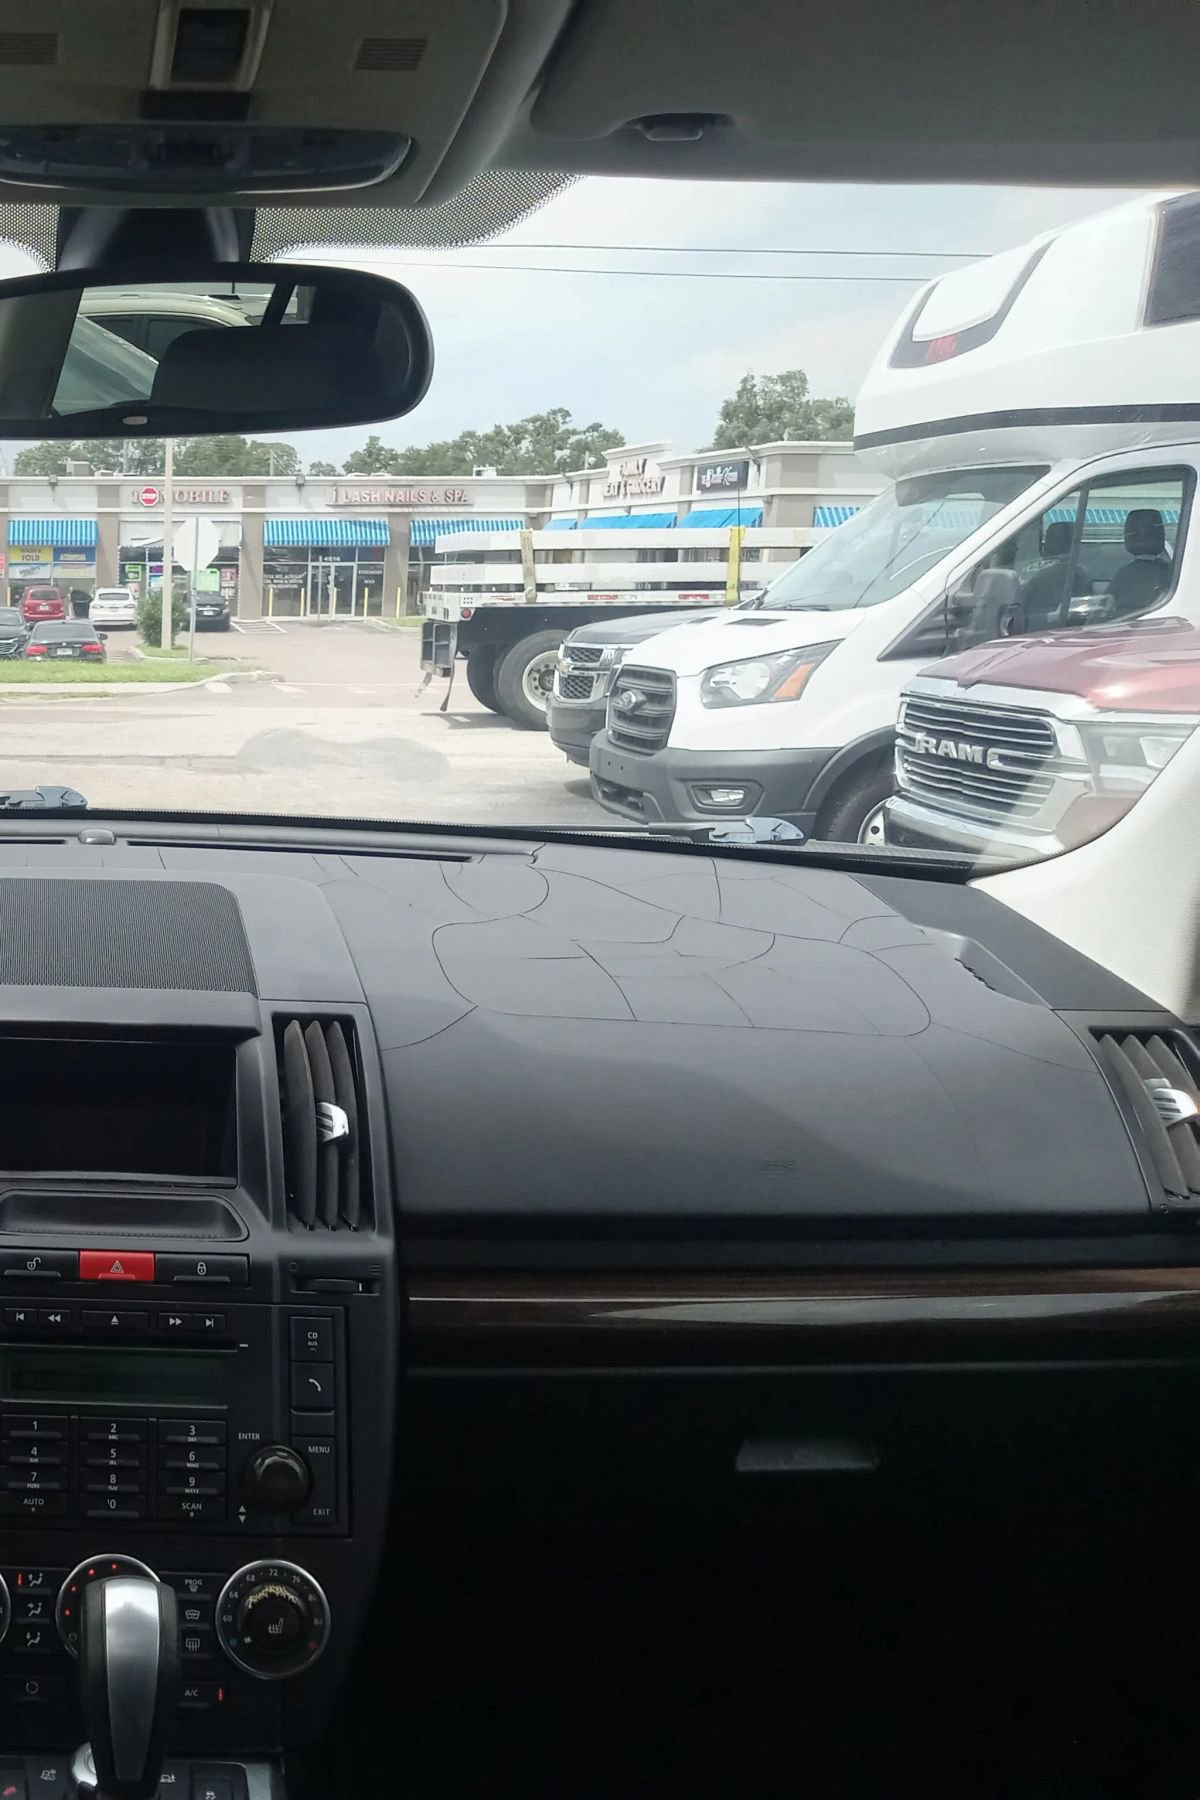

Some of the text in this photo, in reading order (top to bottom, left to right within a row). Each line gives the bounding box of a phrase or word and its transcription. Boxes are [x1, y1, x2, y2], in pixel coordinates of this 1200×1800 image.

[343, 490, 381, 503] LASH
[384, 490, 429, 503] NAILS
[431, 490, 440, 503] &
[444, 489, 468, 503] SPA
[915, 732, 984, 763] RAM
[307, 1331, 319, 1339] CD
[32, 1420, 38, 1431] 1
[110, 1423, 117, 1433] 2
[189, 1425, 196, 1435] 3
[30, 1446, 38, 1456] 4
[110, 1448, 117, 1458] 5
[307, 1446, 330, 1454] MENU
[189, 1451, 196, 1461] 6
[30, 1471, 38, 1481] 7
[109, 1473, 117, 1484] 8
[188, 1476, 196, 1487] 9
[109, 1498, 117, 1509] 0
[181, 1502, 202, 1510] SCAN
[313, 1508, 330, 1516] EXIT
[268, 1569, 279, 1577] 72
[184, 1689, 199, 1697] A/C
